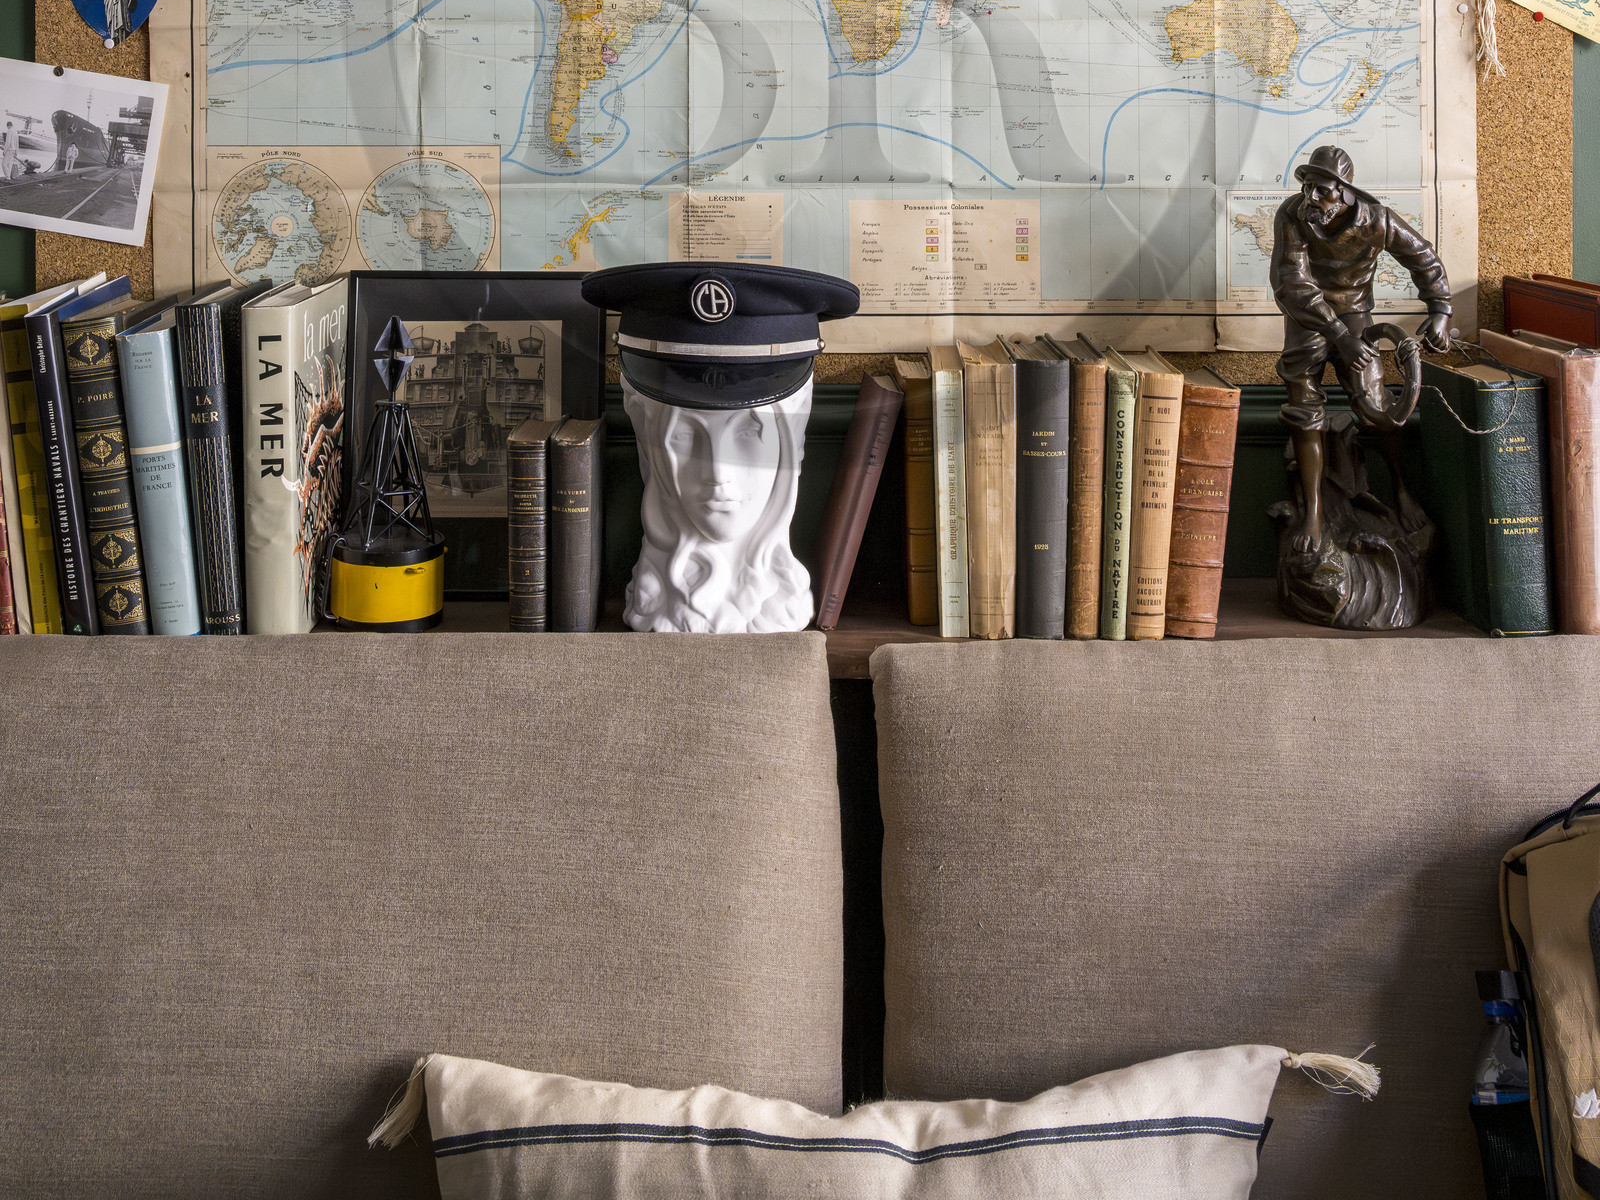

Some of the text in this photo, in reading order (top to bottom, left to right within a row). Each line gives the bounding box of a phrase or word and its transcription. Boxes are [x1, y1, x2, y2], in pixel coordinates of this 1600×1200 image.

[261, 150, 301, 158] PÔLE NORD
[708, 194, 745, 202] LÉGENDE
[303, 304, 345, 363] la mer
[87, 391, 115, 403] POIRÉ
[195, 394, 213, 406] LA
[258, 334, 285, 479] LA MER
[191, 411, 219, 424] MER
[1144, 447, 1171, 456] TECHNIQUE
[50, 445, 63, 479] NAVALS
[142, 455, 166, 464] PORTS
[1143, 459, 1169, 467] NOUVELLE
[135, 463, 176, 474] MARITIMES
[948, 463, 955, 474] DE
[1113, 409, 1125, 531] CONSTRUCTION
[1148, 470, 1156, 478] DE
[142, 482, 172, 492] FRANCE
[1142, 480, 1169, 488] PEINTURE
[55, 483, 70, 533] CHANTIERS
[1501, 515, 1544, 524] TRANSPORT
[1503, 527, 1540, 535] MARITIME
[64, 537, 72, 554] DES
[950, 520, 958, 560] GRAPHIQUE
[1114, 538, 1121, 552] DU
[67, 557, 78, 601] HISTOIRE
[1111, 559, 1122, 619] NAVIRE
[1137, 586, 1162, 596] JACQUES
[205, 613, 241, 625] AROUSS
